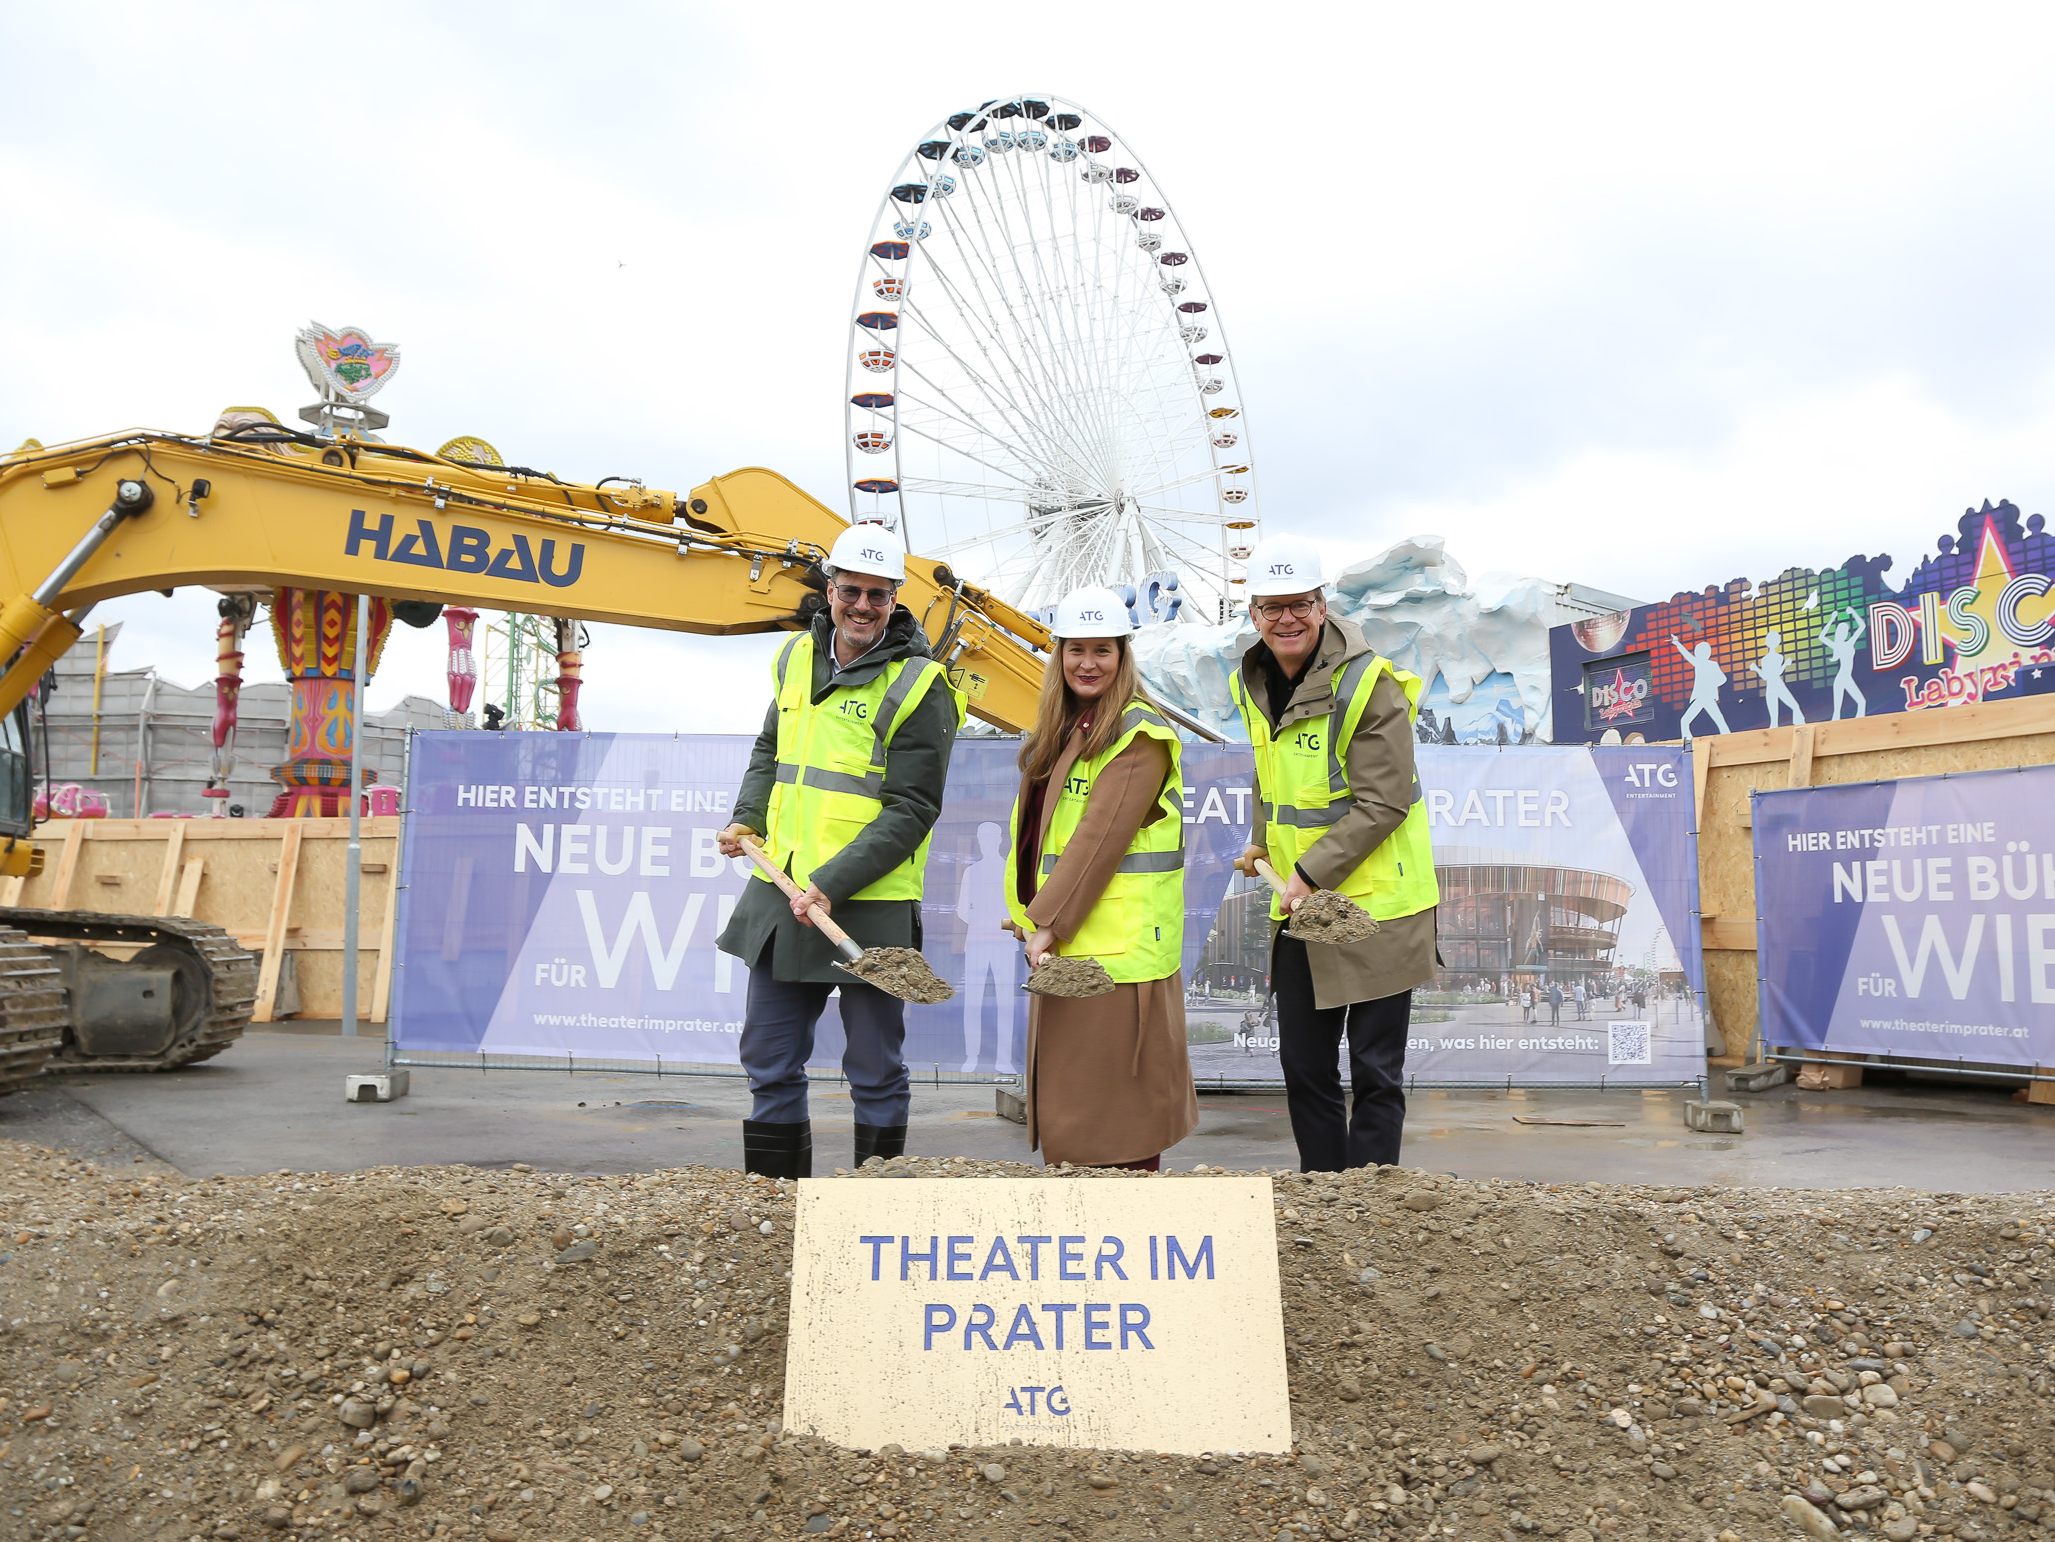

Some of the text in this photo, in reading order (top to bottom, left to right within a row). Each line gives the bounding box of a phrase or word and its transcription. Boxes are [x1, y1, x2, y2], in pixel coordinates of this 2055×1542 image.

[345, 509, 585, 587] HABAU
[860, 549, 884, 561] ATG
[1267, 564, 1294, 575] ATG
[1079, 611, 1104, 621] ATG
[1592, 678, 1648, 708] DISCO
[839, 700, 867, 719] ATG
[1295, 733, 1320, 750] ATG
[1624, 763, 1679, 788] ATG
[456, 785, 730, 813] HIER ENTSTEHT EINE
[1626, 792, 1677, 800] ENTERTAINMENT
[513, 823, 674, 877] NEUE
[1787, 821, 1996, 853] HIER ENTSTEHT EINE
[1832, 857, 1955, 904] NEUE
[534, 957, 588, 988] FÜR
[1857, 972, 1898, 998] FÜR
[533, 1011, 744, 1035] www.theaterimprater.at
[1859, 1016, 2030, 1039] www.theaterimprater.at
[1439, 1036, 1475, 1051] was
[1479, 1034, 1514, 1051] hier
[1518, 1034, 1600, 1051] entsteht:
[859, 1235, 1215, 1281] THEATER IM
[923, 1303, 1156, 1350] PRATER
[1003, 1385, 1072, 1416] ATG
